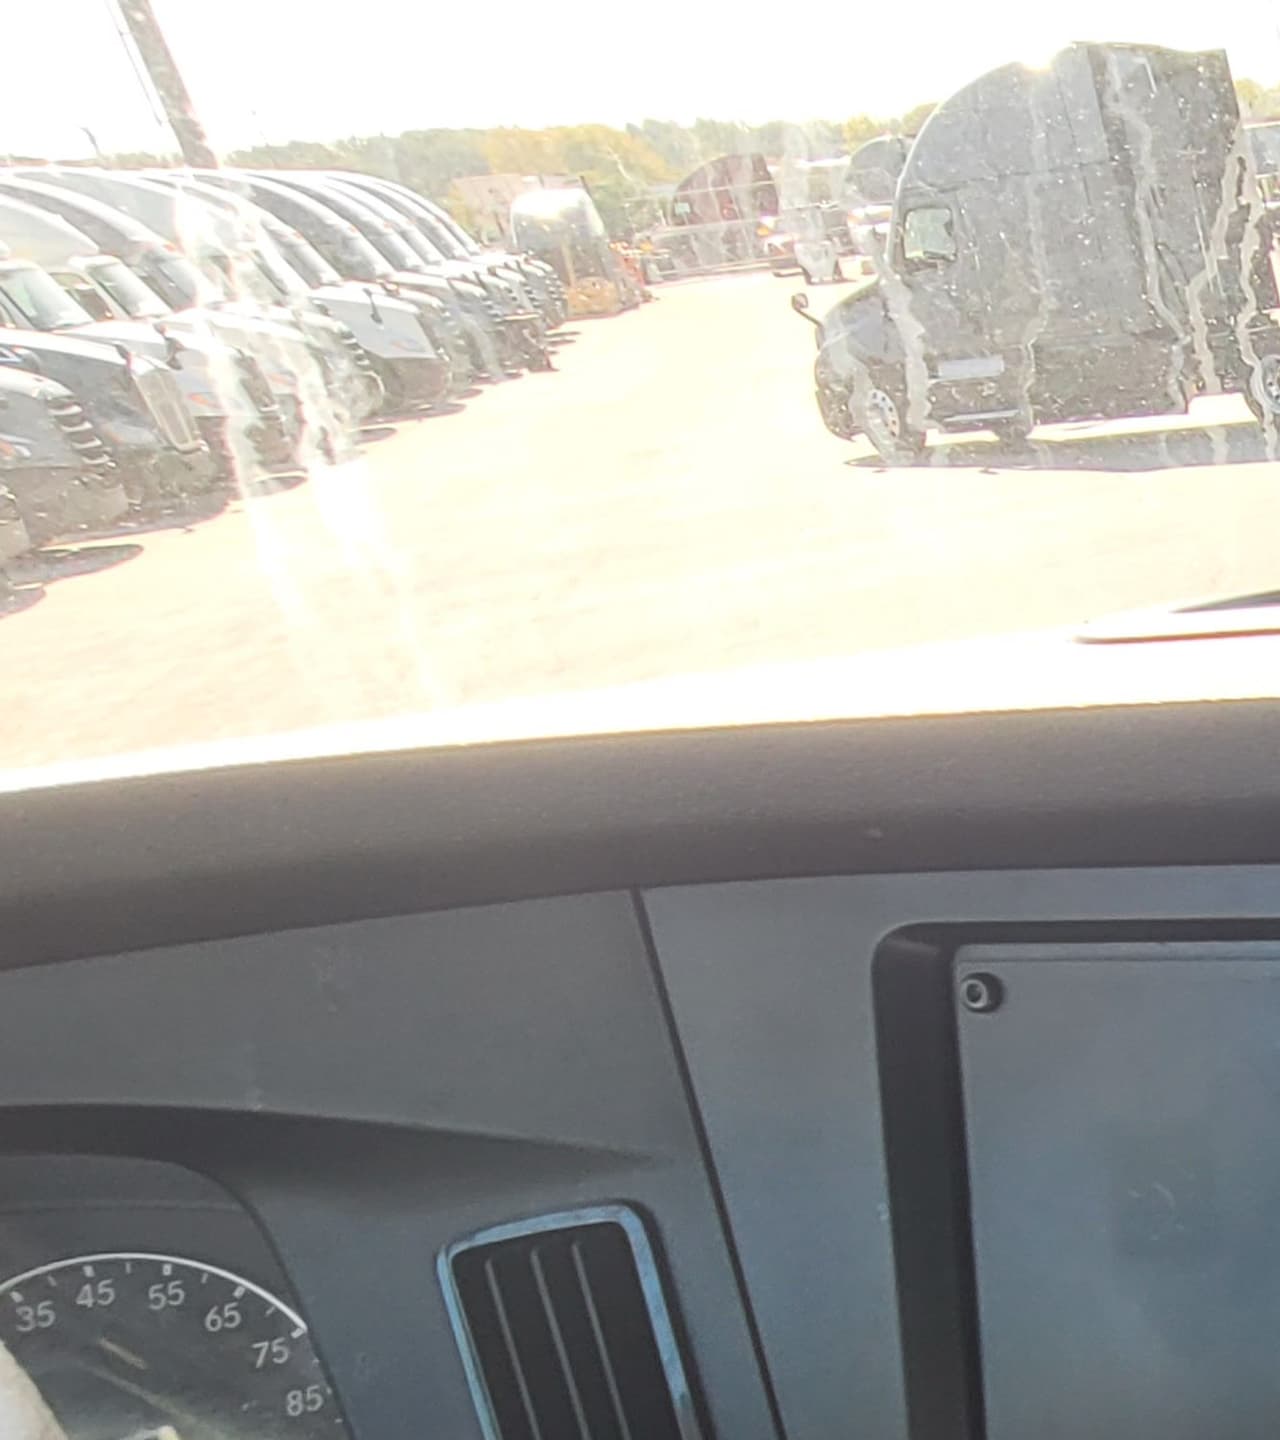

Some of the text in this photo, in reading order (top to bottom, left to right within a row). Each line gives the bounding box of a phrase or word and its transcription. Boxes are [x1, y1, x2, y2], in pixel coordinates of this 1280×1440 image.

[75, 1279, 117, 1309] 45
[147, 1281, 187, 1312] 55
[15, 1301, 56, 1333] 35
[204, 1301, 243, 1332] 65
[251, 1338, 291, 1369] 75
[285, 1385, 325, 1417] 85
